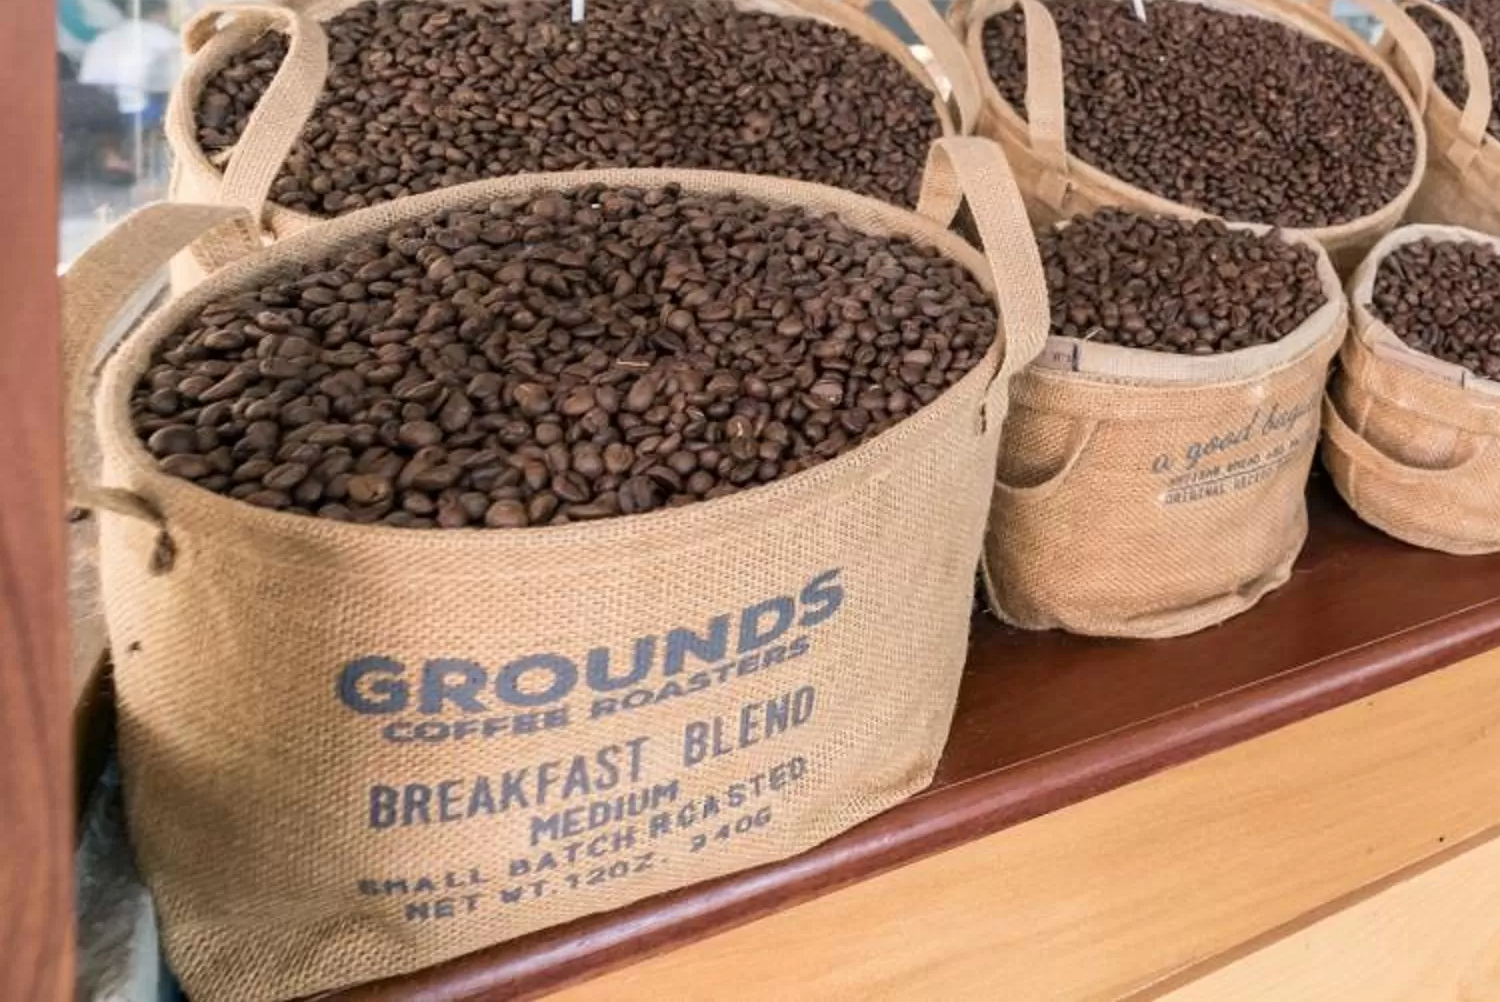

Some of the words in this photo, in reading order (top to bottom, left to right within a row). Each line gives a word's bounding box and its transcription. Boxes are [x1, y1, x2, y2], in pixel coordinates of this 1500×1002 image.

[1185, 406, 1261, 471] good
[335, 566, 845, 715] GROUNDS
[382, 708, 569, 742] COFFEE
[590, 634, 811, 719] ROASTERS
[369, 736, 651, 829] BREAKFAST
[684, 685, 815, 767] BLEND
[358, 868, 489, 896] SMALL
[509, 826, 637, 877] BATCH
[649, 755, 808, 838] ROASTED
[529, 779, 680, 846] MEDIUM
[405, 894, 482, 921] NET
